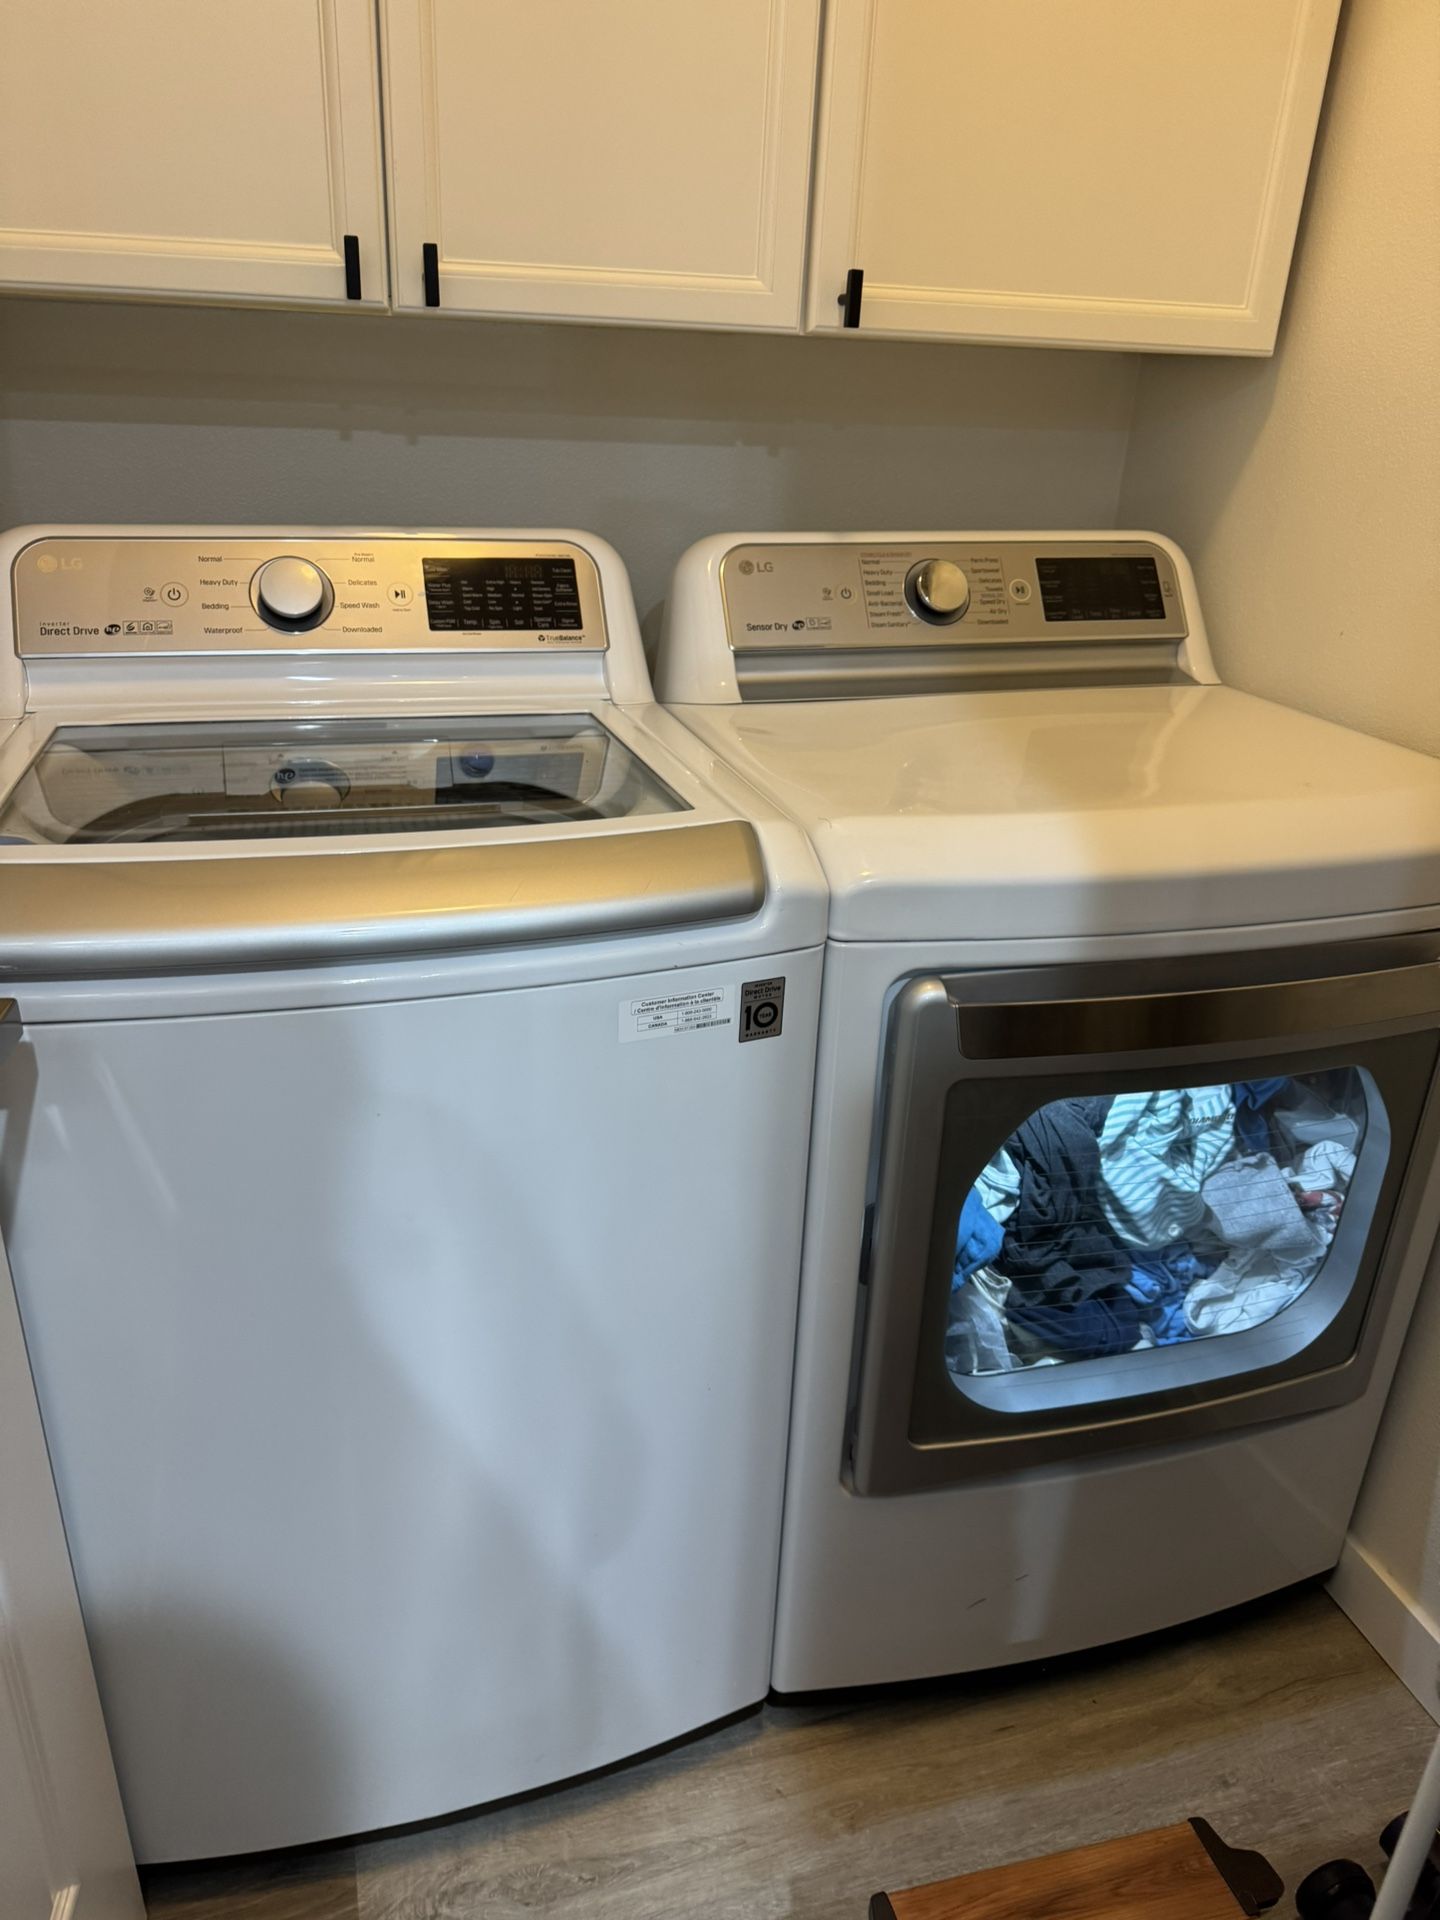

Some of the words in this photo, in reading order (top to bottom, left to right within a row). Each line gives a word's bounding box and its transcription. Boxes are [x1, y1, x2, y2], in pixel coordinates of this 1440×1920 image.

[61, 558, 82, 569] LG
[756, 561, 774, 573] LG
[202, 603, 229, 611] Bedding
[40, 627, 70, 635] Direct
[73, 627, 99, 635] Drive
[746, 623, 772, 631] Sensor
[774, 622, 788, 632] Dry
[745, 988, 764, 997] Direct
[764, 985, 782, 993] Drive
[641, 999, 667, 1008] Customer
[745, 1002, 779, 1031] 10
